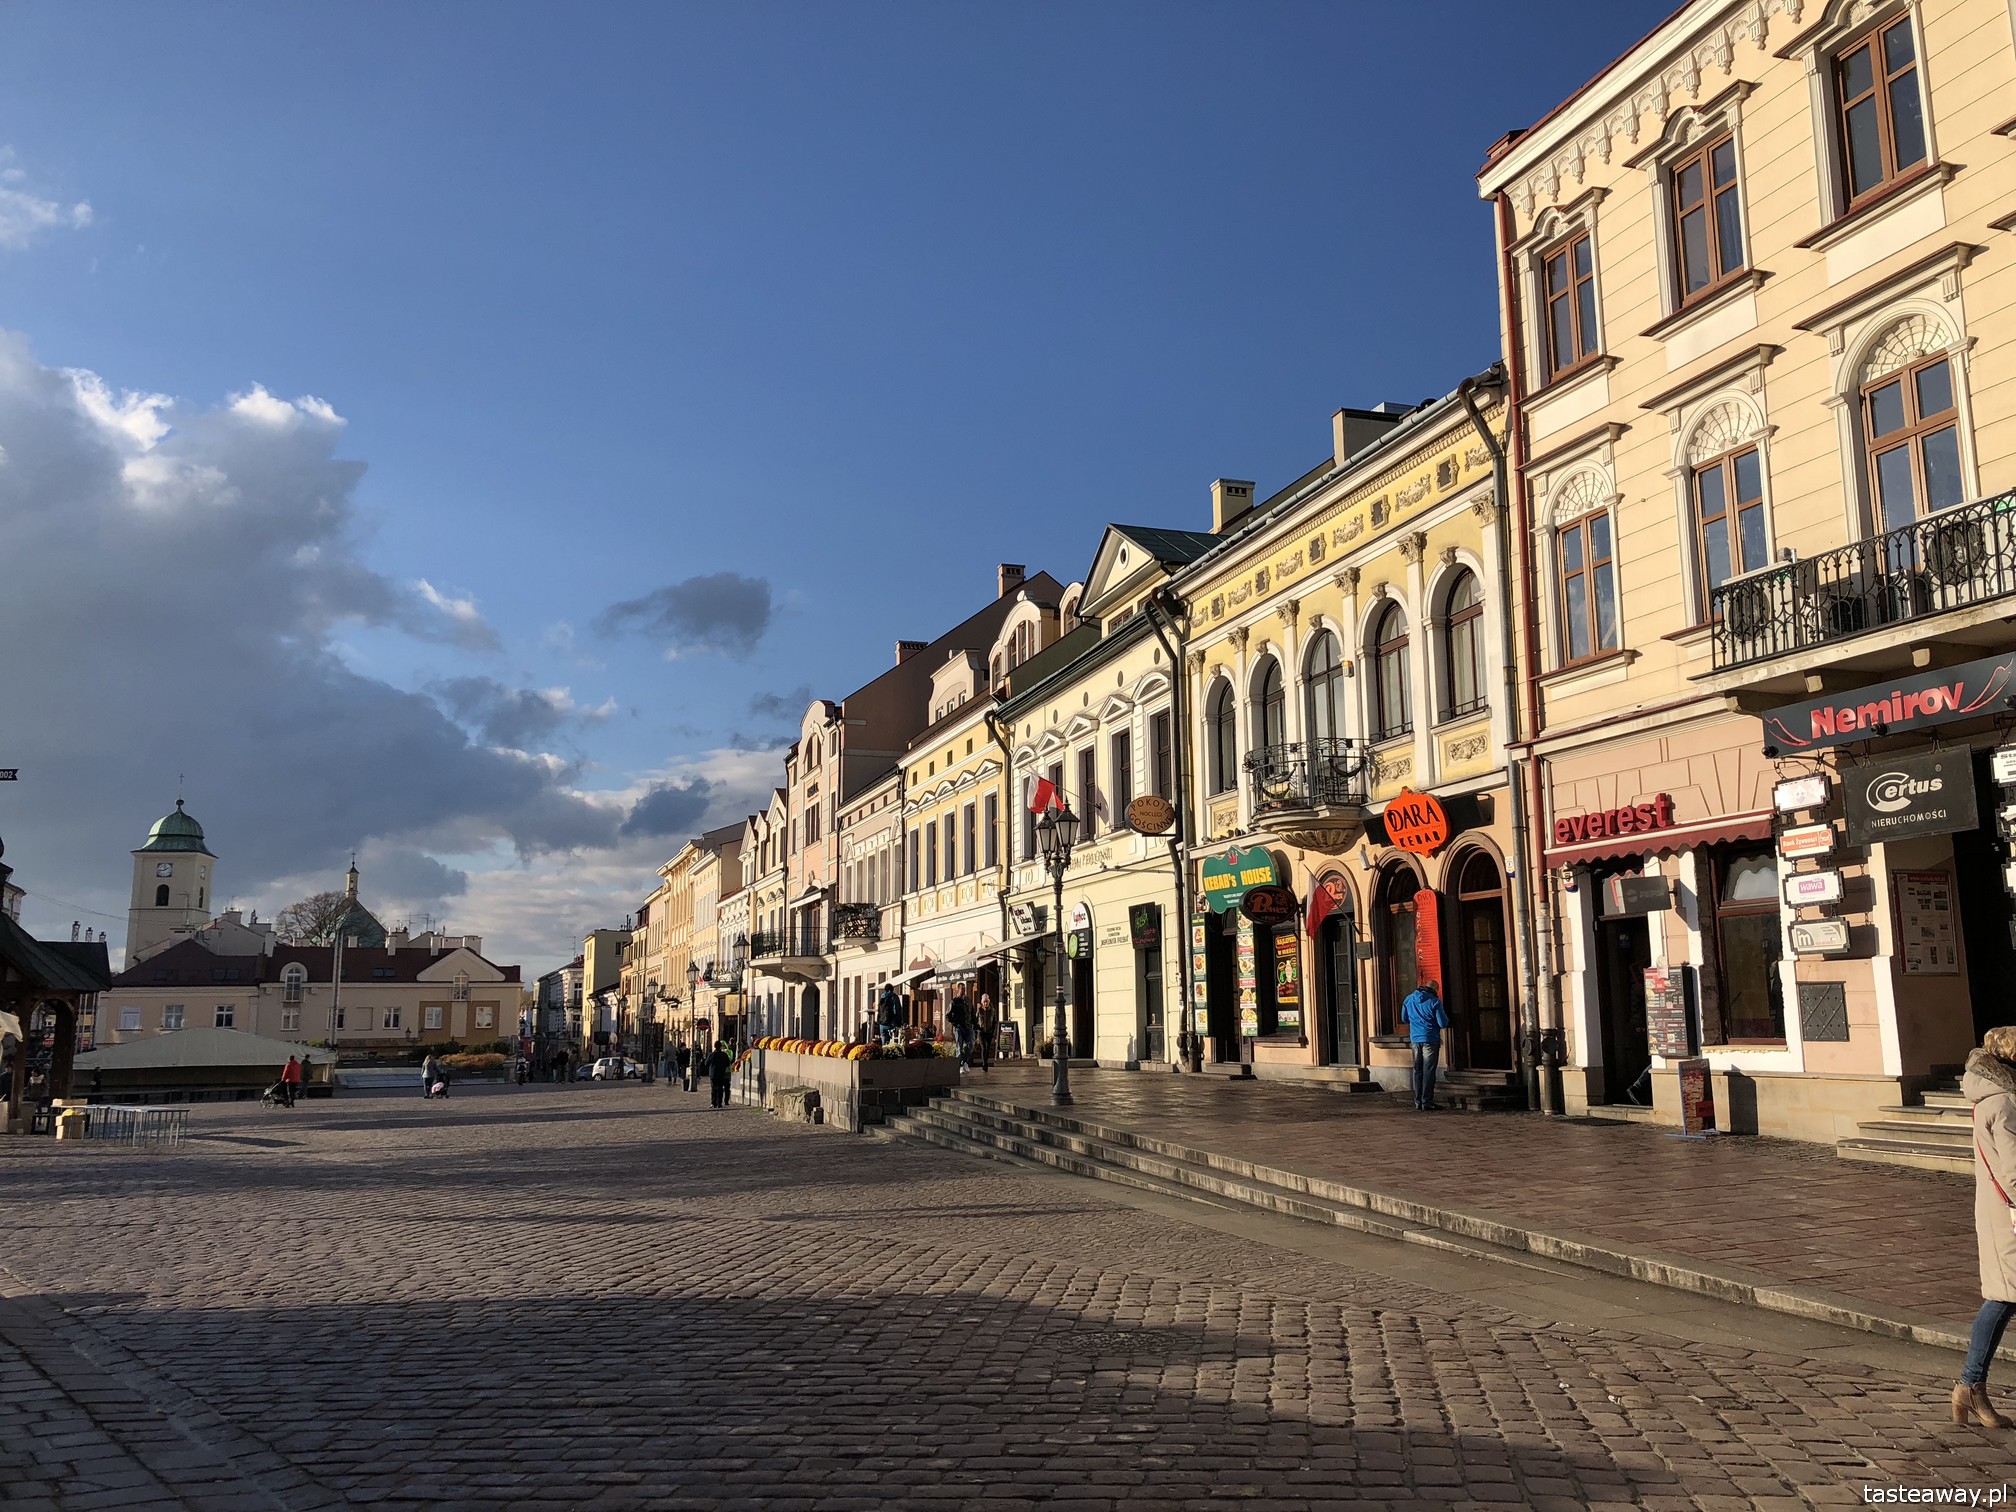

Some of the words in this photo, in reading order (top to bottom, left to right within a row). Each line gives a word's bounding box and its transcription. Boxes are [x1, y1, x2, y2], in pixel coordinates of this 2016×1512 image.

[1811, 682, 1964, 739] Nemirov
[1866, 772, 1943, 812] Certus
[1130, 798, 1171, 815] POKOJE
[1129, 813, 1172, 830] GOŚCINNE
[1387, 801, 1440, 832] DARA
[1555, 793, 1667, 842] everest
[1872, 809, 1947, 828] NIERUCHOMOŚCI
[1399, 831, 1440, 847] KEBAB
[1782, 839, 1795, 847] Bank
[1204, 873, 1237, 891] KEBAB's
[1240, 866, 1272, 885] HOUSE
[1800, 880, 1824, 893] wawa
